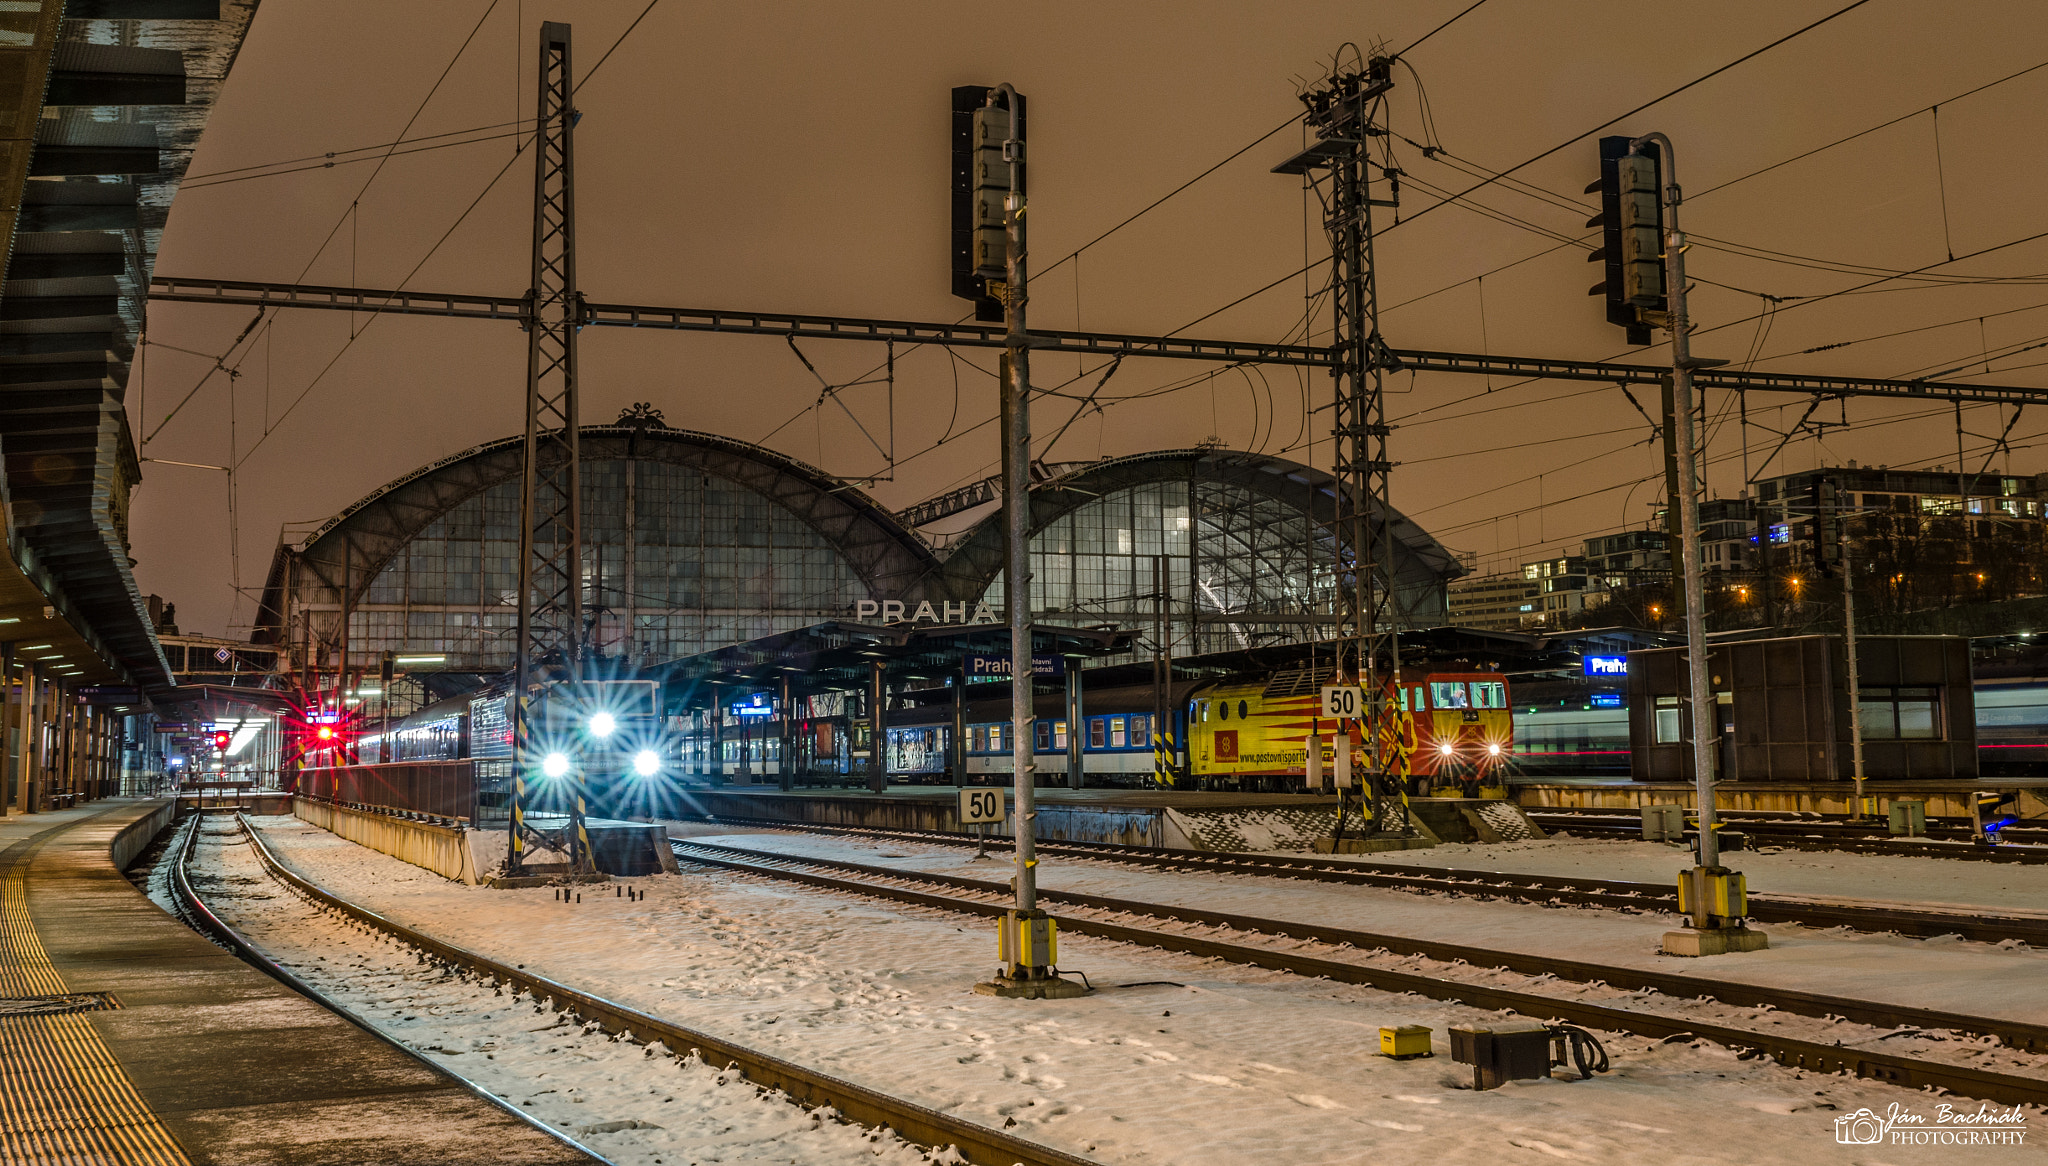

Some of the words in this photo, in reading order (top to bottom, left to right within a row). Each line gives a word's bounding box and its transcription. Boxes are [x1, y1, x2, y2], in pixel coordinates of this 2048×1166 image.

[856, 599, 999, 623] PRAHA
[973, 657, 1014, 673] Prah
[1330, 689, 1354, 715] 50
[970, 791, 997, 818] 50
